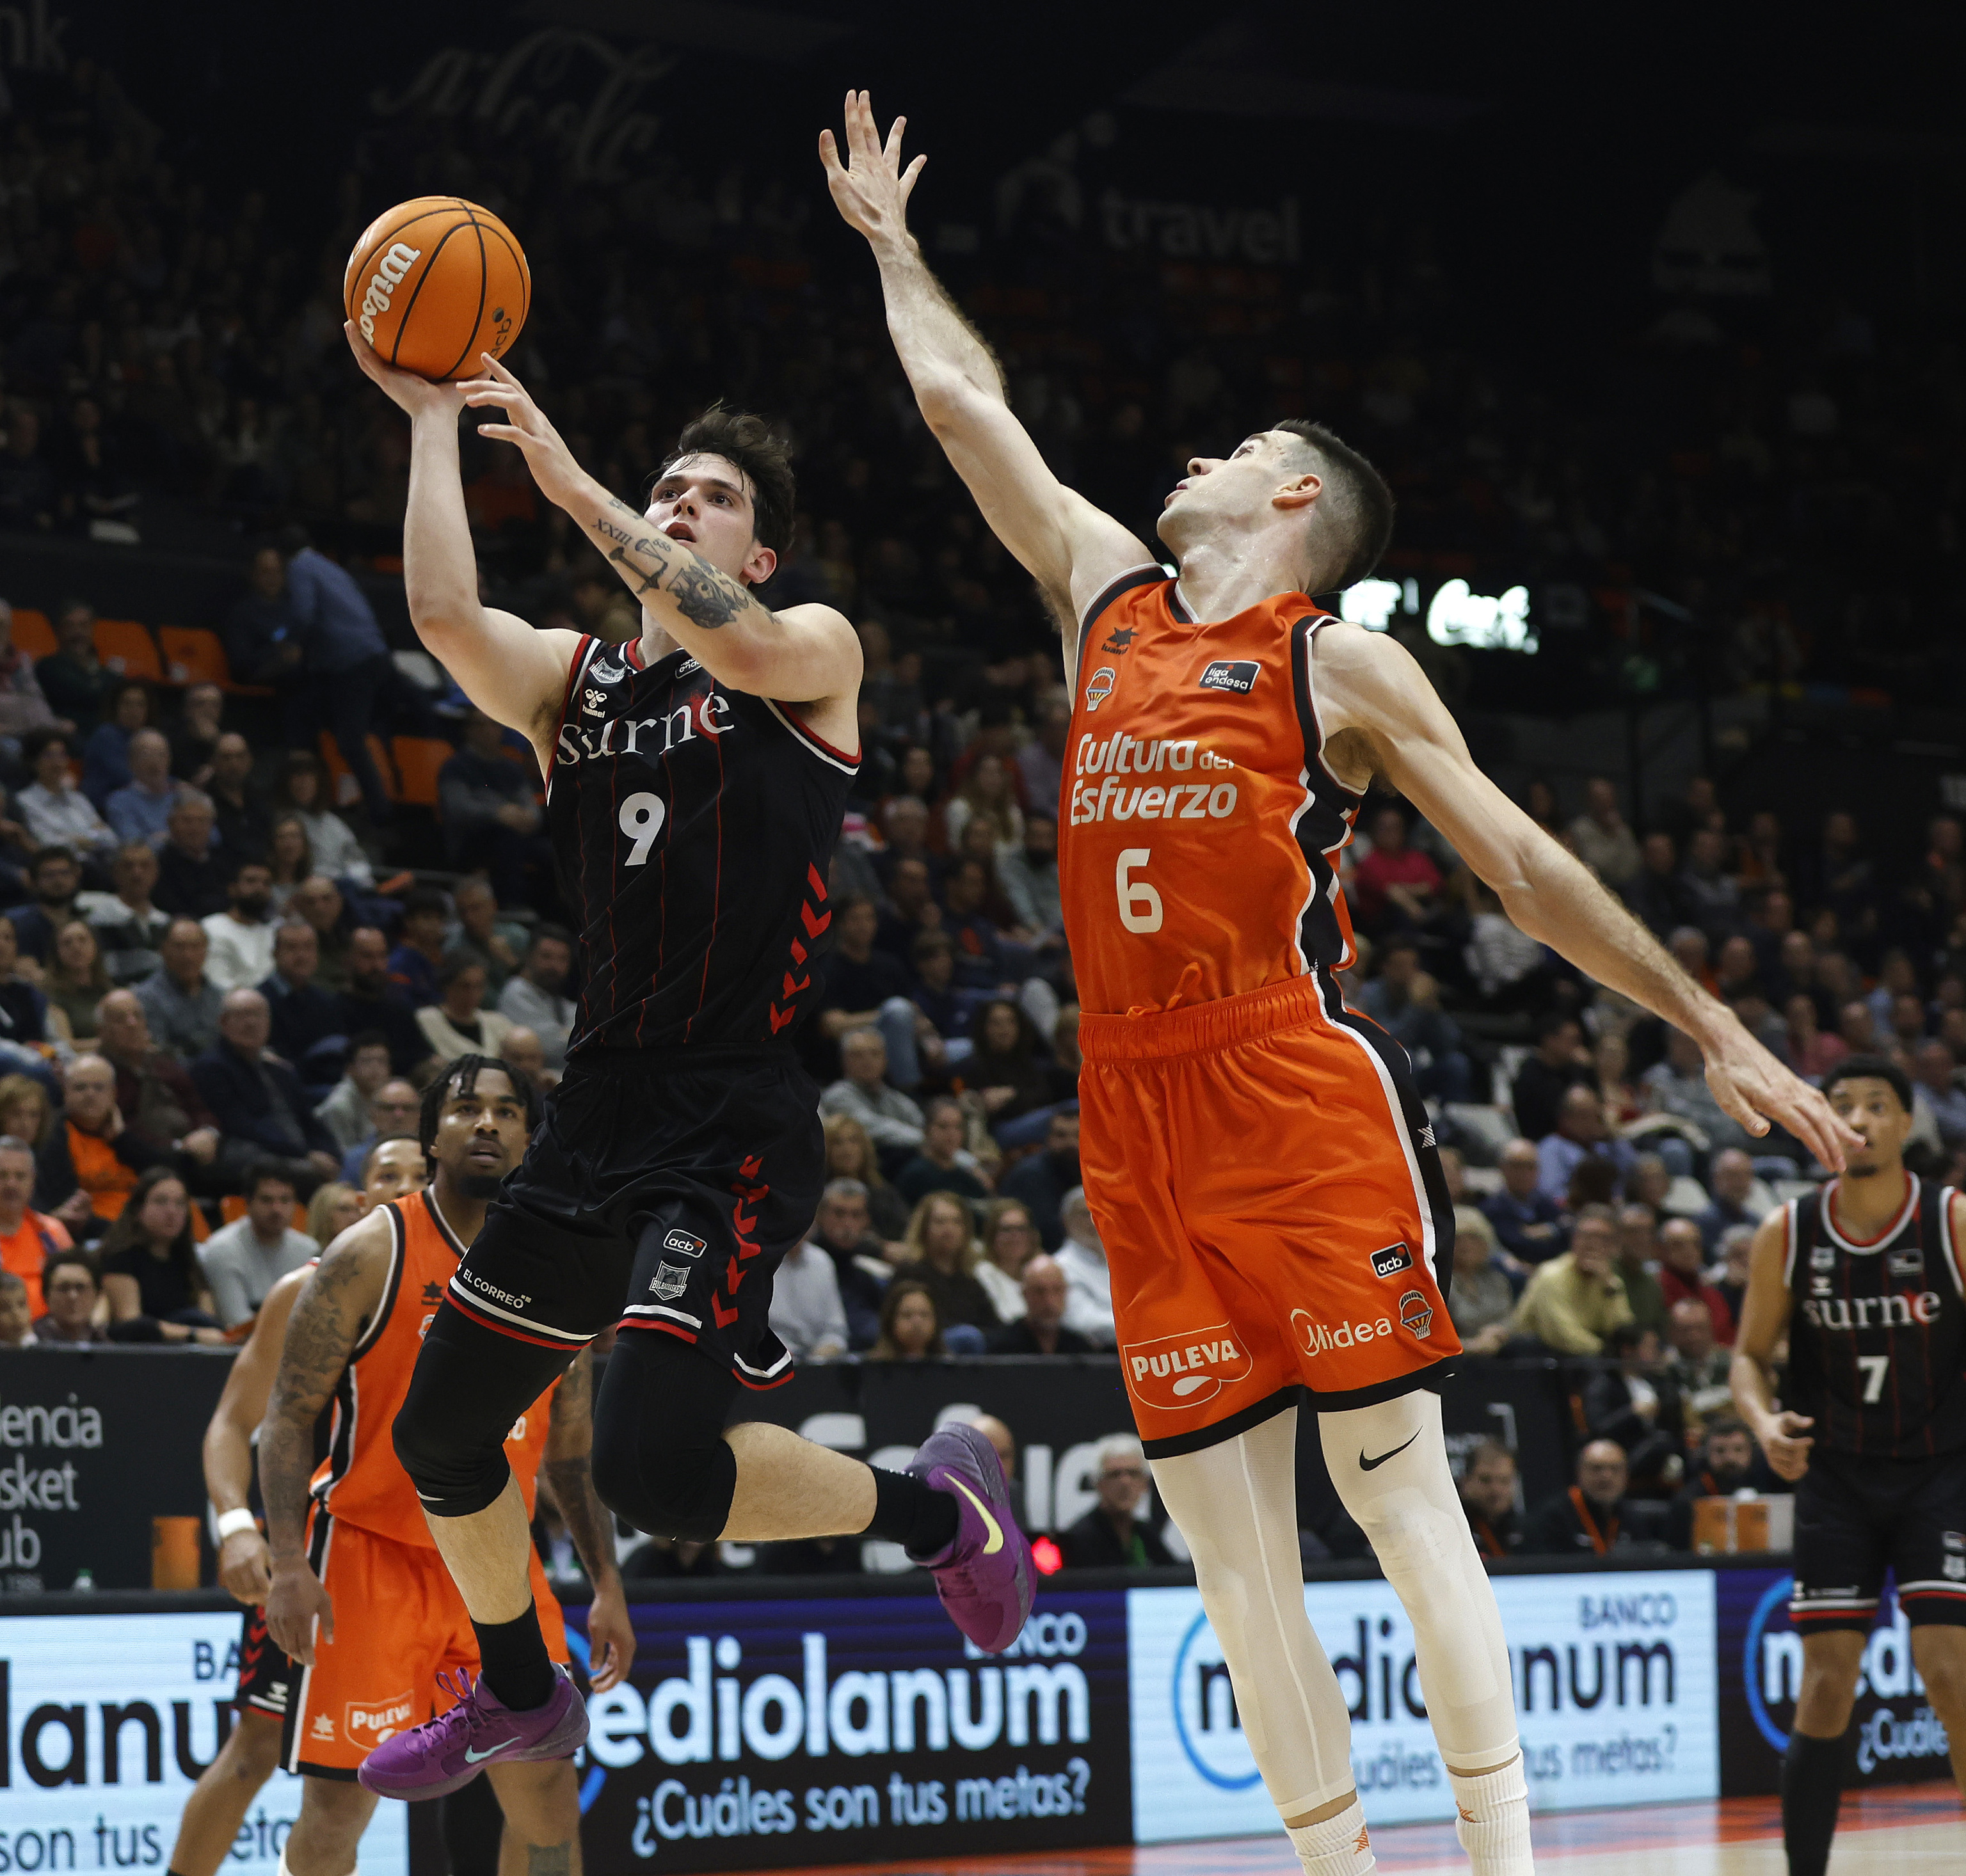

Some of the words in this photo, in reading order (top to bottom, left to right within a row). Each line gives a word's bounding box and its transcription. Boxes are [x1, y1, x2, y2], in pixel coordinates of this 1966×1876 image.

[1099, 186, 1300, 264] travel
[1204, 676, 1249, 690] endesa
[1208, 667, 1229, 678] liga
[557, 691, 735, 767] surne
[582, 704, 606, 719] hummel
[1076, 731, 1198, 776] Cultura
[1070, 775, 1238, 827] Esfuerzo
[618, 791, 666, 867] 9
[1115, 848, 1164, 934] 6
[668, 1237, 694, 1252] acb
[1377, 1257, 1403, 1274] acb
[463, 1268, 473, 1284] EL
[474, 1278, 525, 1309] CORREO
[1802, 1291, 1942, 1330] surne
[1290, 1307, 1394, 1357] Midea
[1131, 1339, 1241, 1383] PULEVA
[1856, 1355, 1890, 1404] 7
[0, 1392, 103, 1449] encia
[1578, 1592, 1678, 1628] BANCO
[195, 1639, 242, 1681] BA
[0, 1659, 236, 1789] lanu
[572, 1632, 1091, 1769] ediolanum
[631, 1774, 797, 1858] ¿Cuáles
[804, 1785, 881, 1831] son
[887, 1771, 948, 1827] tus
[955, 1756, 1092, 1822] metas?
[93, 1812, 162, 1867] tus
